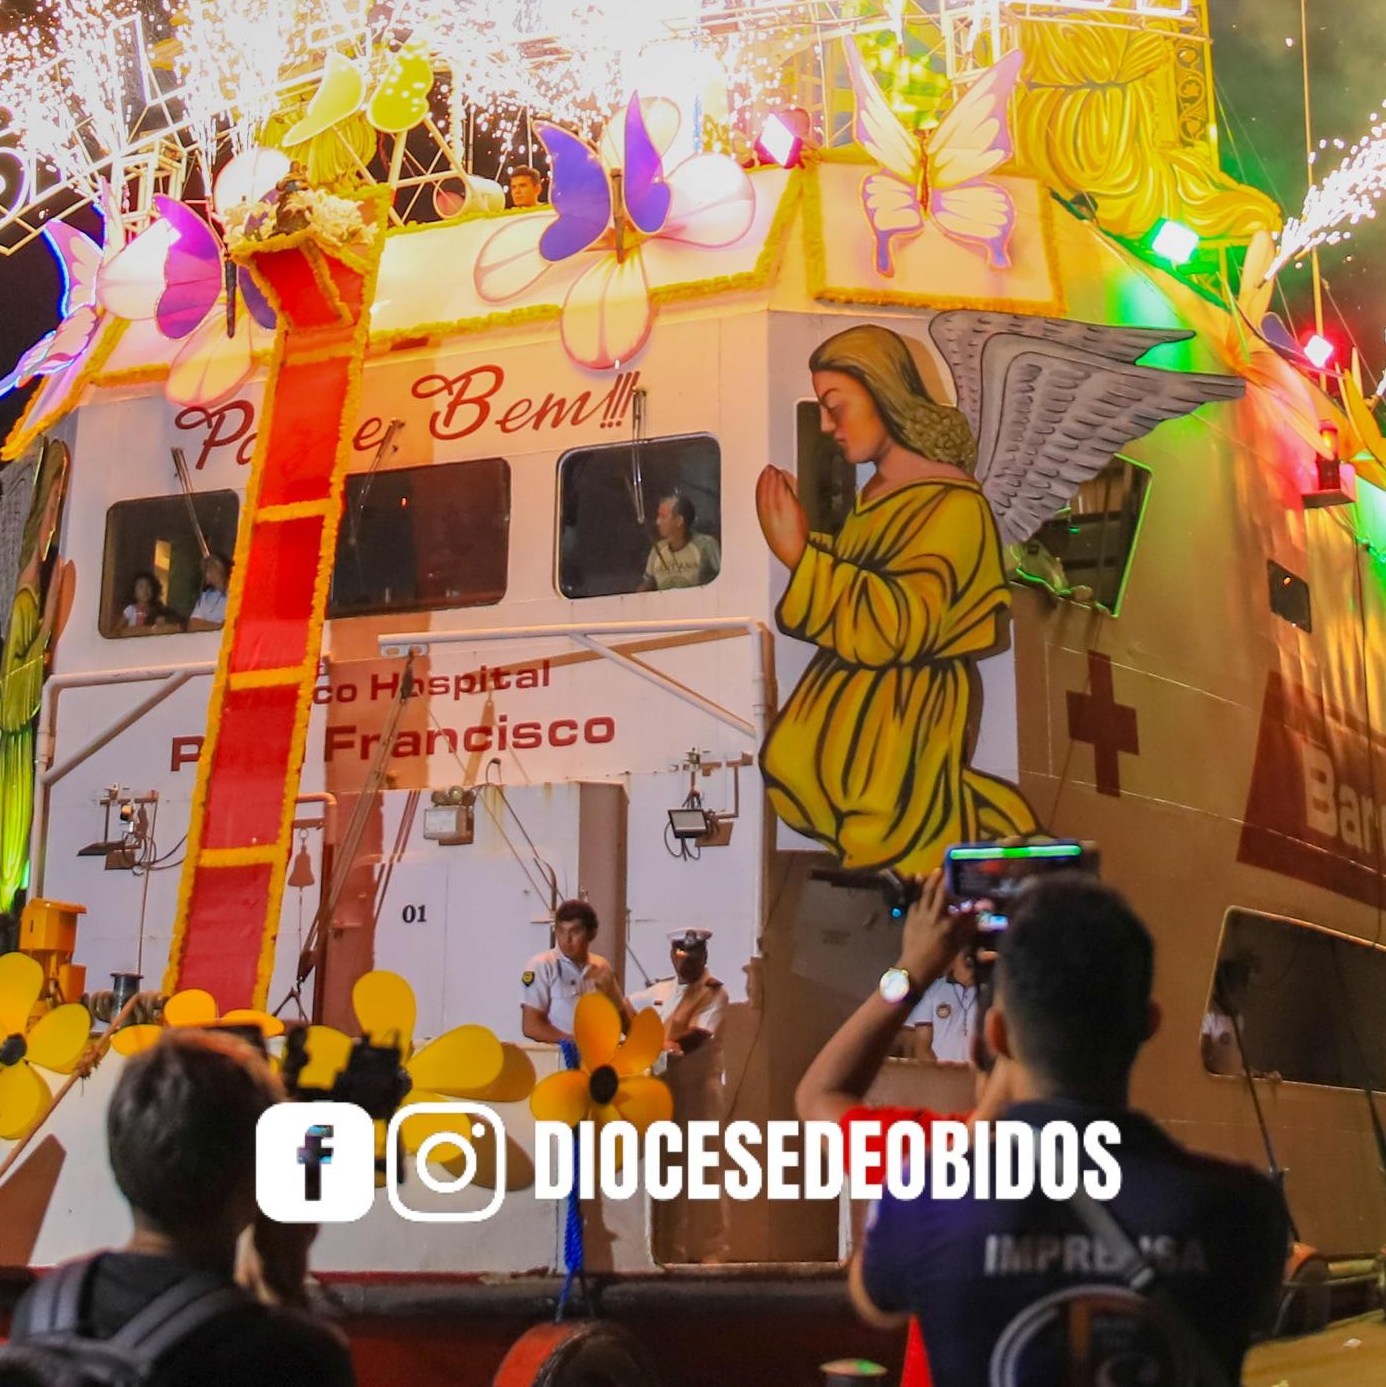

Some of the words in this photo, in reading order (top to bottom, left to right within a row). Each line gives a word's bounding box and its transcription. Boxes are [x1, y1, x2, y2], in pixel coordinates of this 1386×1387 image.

[353, 417, 384, 451] e
[411, 364, 641, 441] Bem!!!
[370, 660, 551, 702] Hospital
[324, 714, 615, 763] Francisco
[402, 904, 427, 923] 01
[984, 1233, 1207, 1277] IMPRESA
